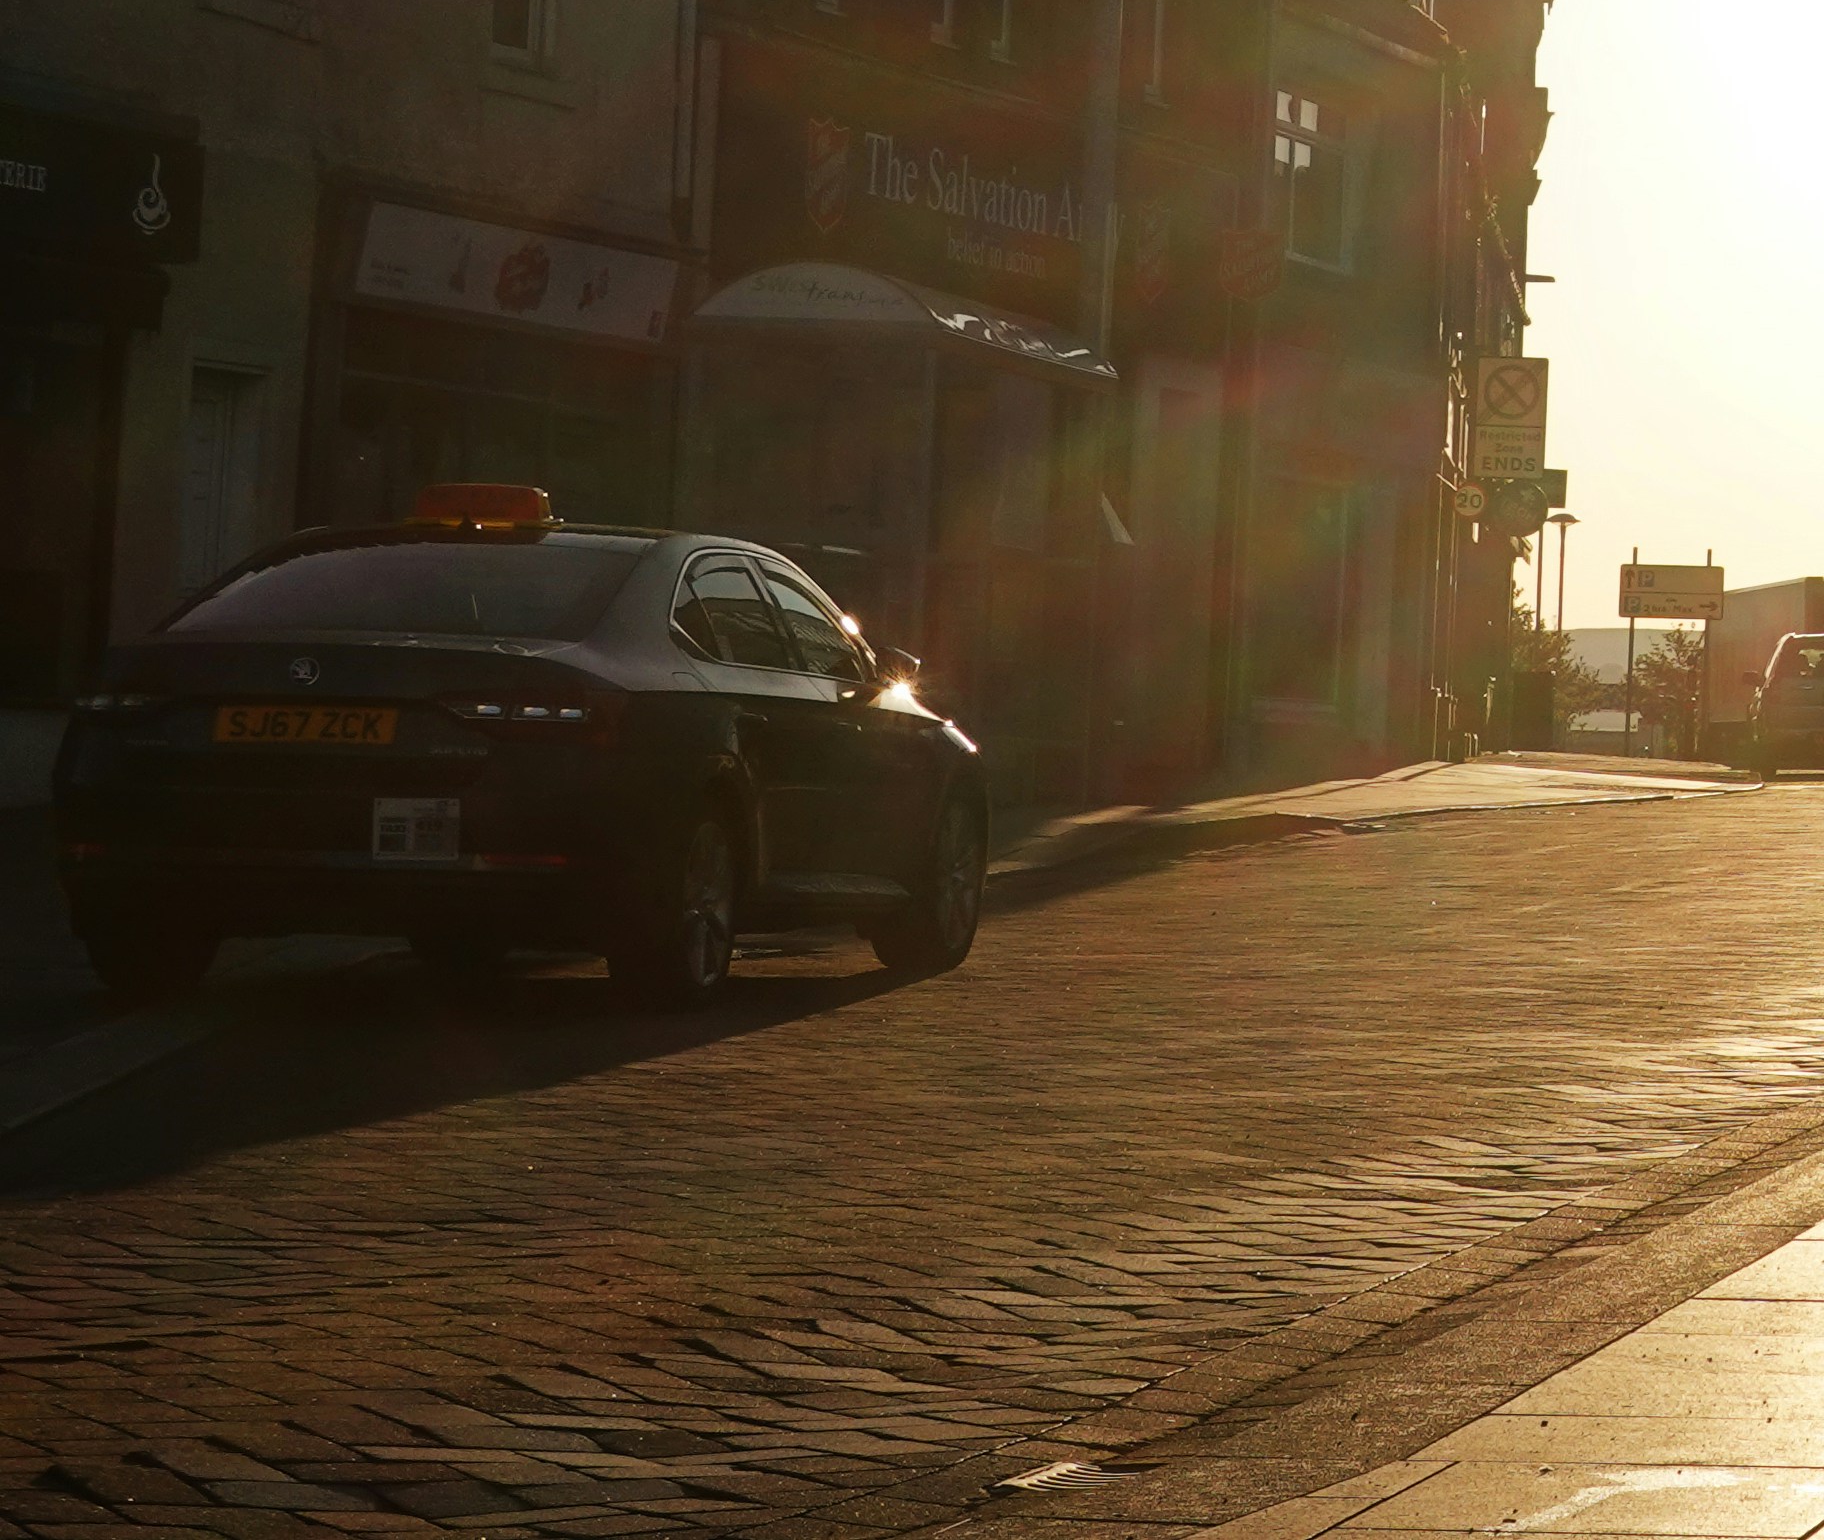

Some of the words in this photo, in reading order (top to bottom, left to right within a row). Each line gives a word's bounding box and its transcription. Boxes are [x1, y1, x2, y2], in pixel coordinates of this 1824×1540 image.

[864, 131, 920, 205] The
[926, 146, 1048, 236] Salvation
[1005, 250, 1047, 280] action
[1479, 430, 1542, 442] Restricted
[1495, 443, 1524, 454] Zone
[1482, 456, 1537, 472] ENDS
[1456, 491, 1483, 509] 20
[1643, 603, 1651, 613] 2
[228, 710, 313, 738] SJ67
[319, 711, 384, 740] ZCK
